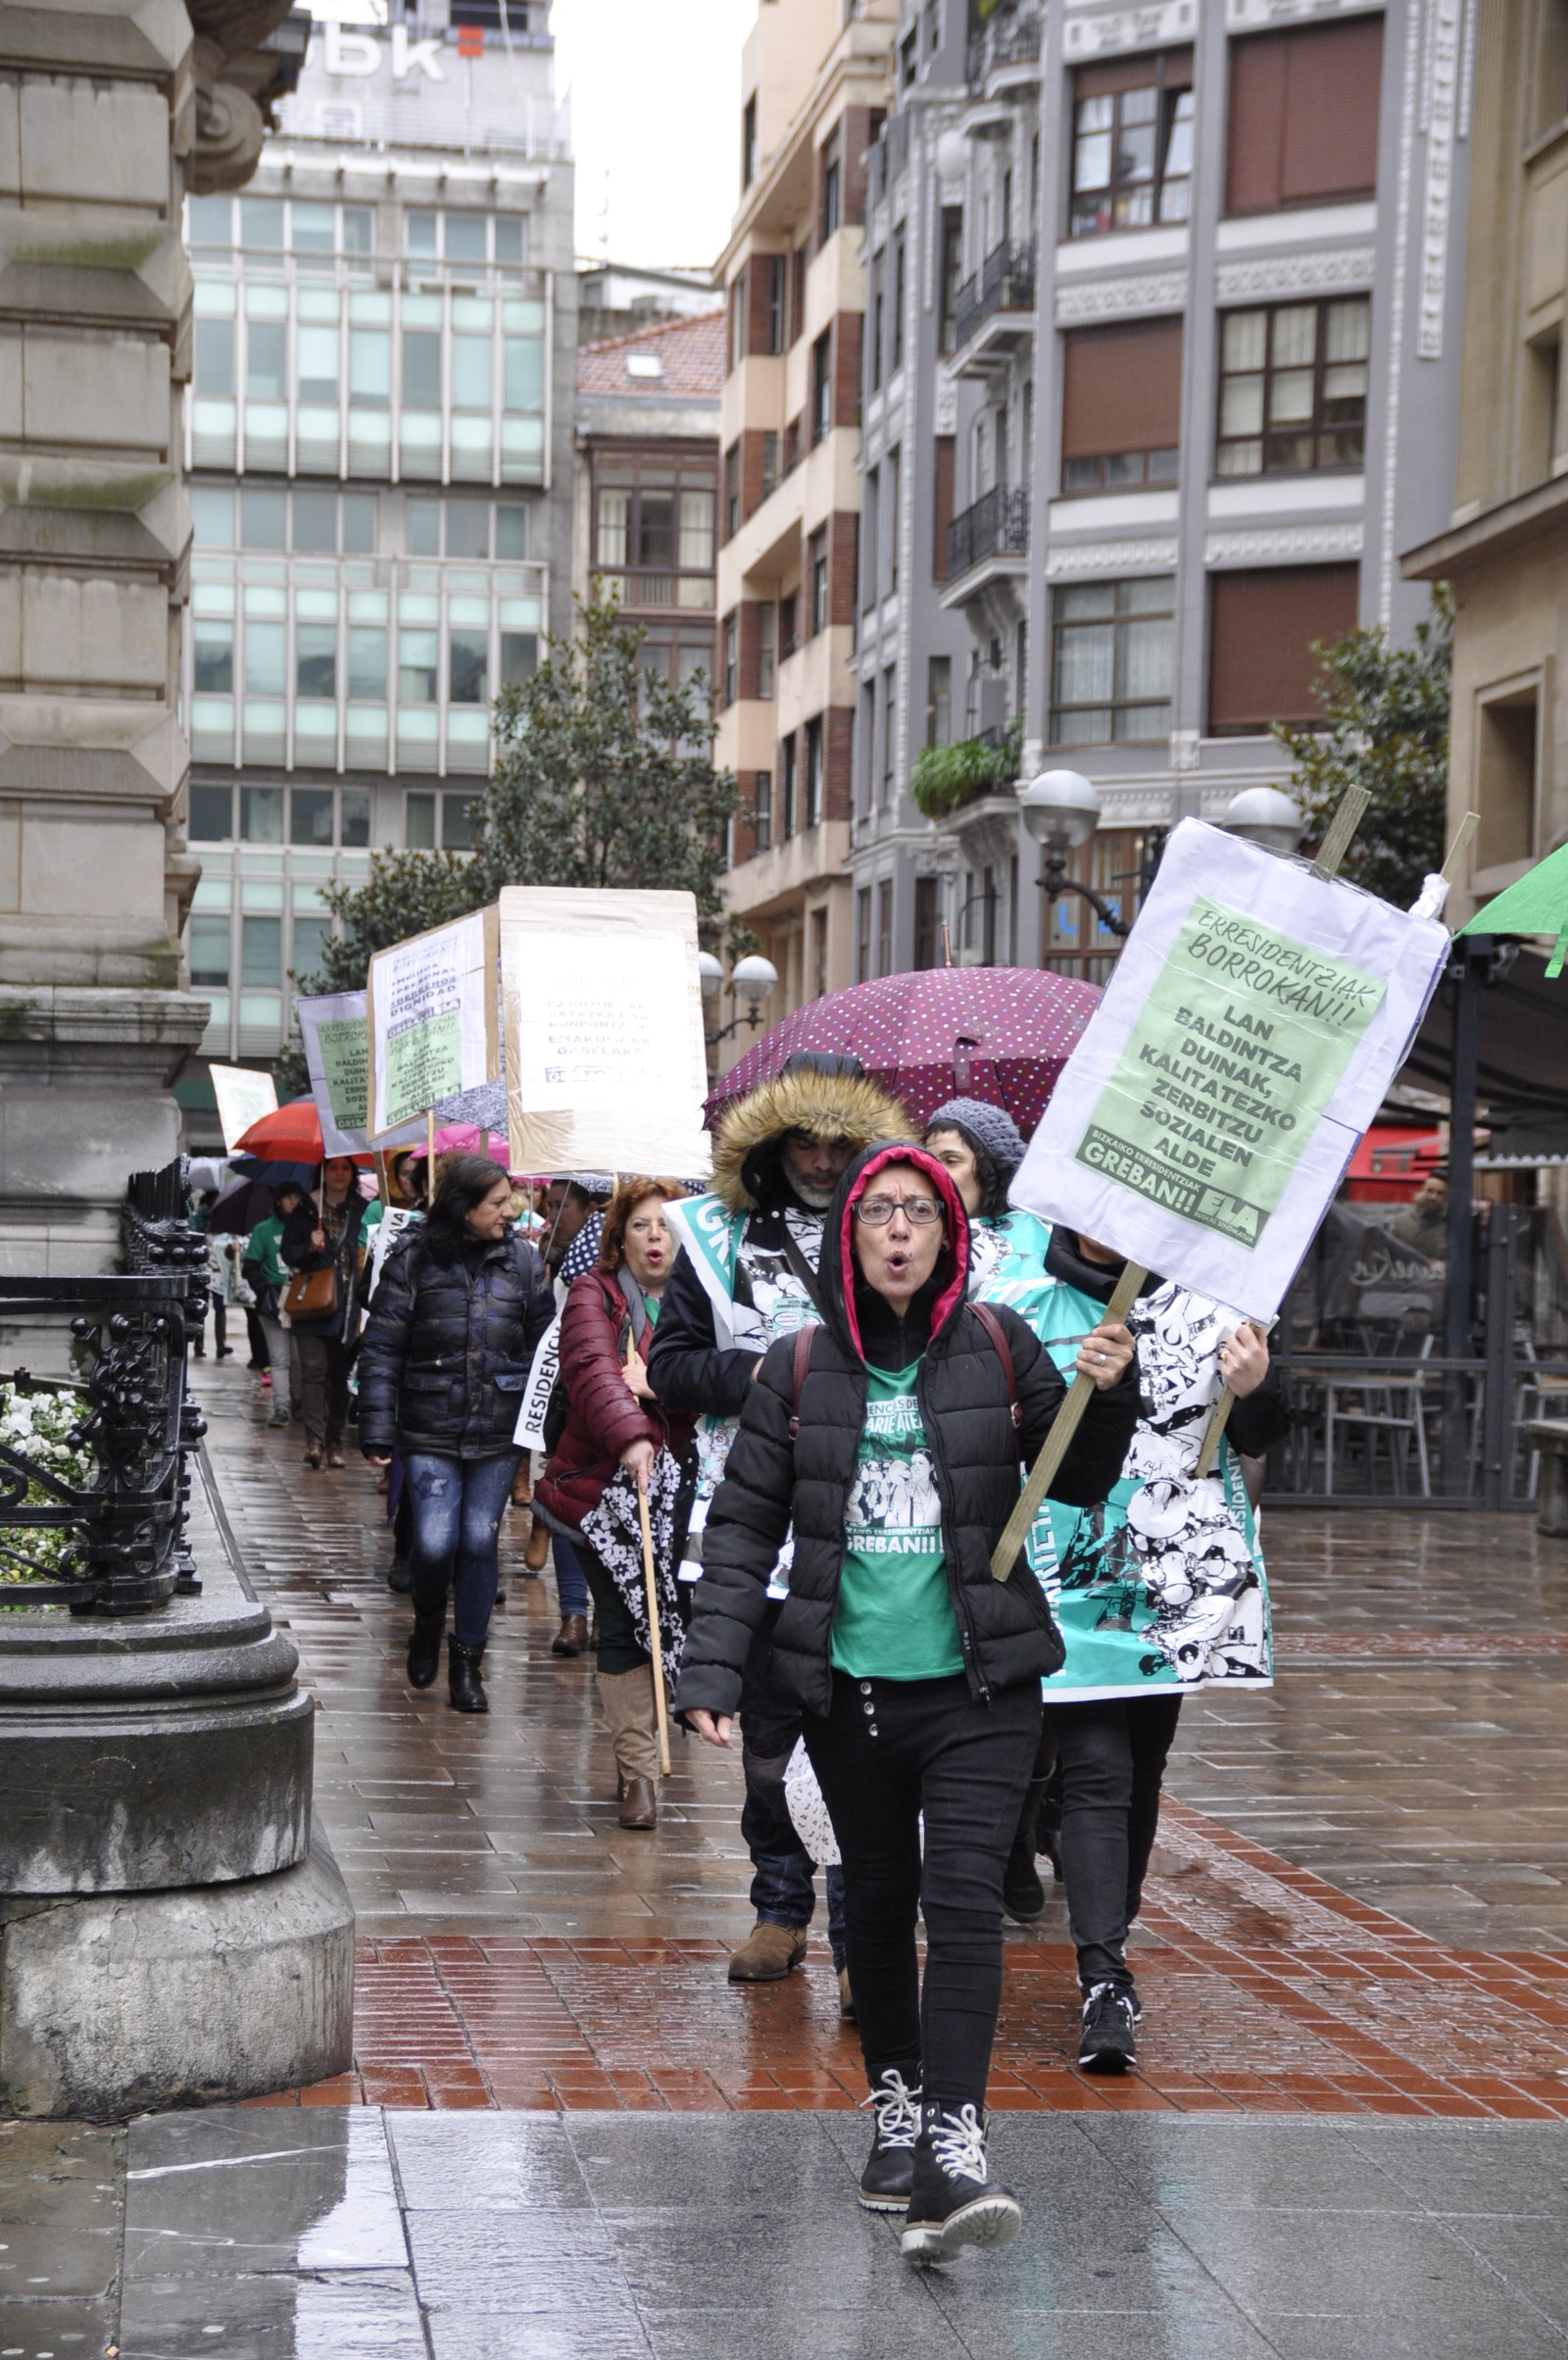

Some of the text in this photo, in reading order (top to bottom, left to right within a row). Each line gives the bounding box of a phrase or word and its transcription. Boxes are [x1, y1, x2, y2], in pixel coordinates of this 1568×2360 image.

[305, 22, 446, 81] bk
[1188, 933, 1355, 1027] BORROKAN!!
[1198, 910, 1376, 1008] ERRESIDENTZIAK
[390, 985, 456, 1017] DIGNIDAD
[1224, 1005, 1274, 1041] LAN
[344, 1067, 368, 1076] DUIN
[1174, 1007, 1301, 1082] BALDINTZA
[1180, 1039, 1272, 1099] DUINAK,
[333, 1076, 368, 1087] KALITA
[1140, 1044, 1297, 1131] KALITATEZKO
[1151, 1078, 1263, 1144] ZERBITZU
[1092, 1129, 1201, 1192] BIZKAIKO ERRESIDENTZIAK
[1140, 1100, 1253, 1167] SOZIALEN
[1153, 1137, 1216, 1177] ALDE
[1085, 1142, 1197, 1212] GREBAN!!
[1197, 1188, 1259, 1238] ELA
[525, 1327, 561, 1434] RESIDENC
